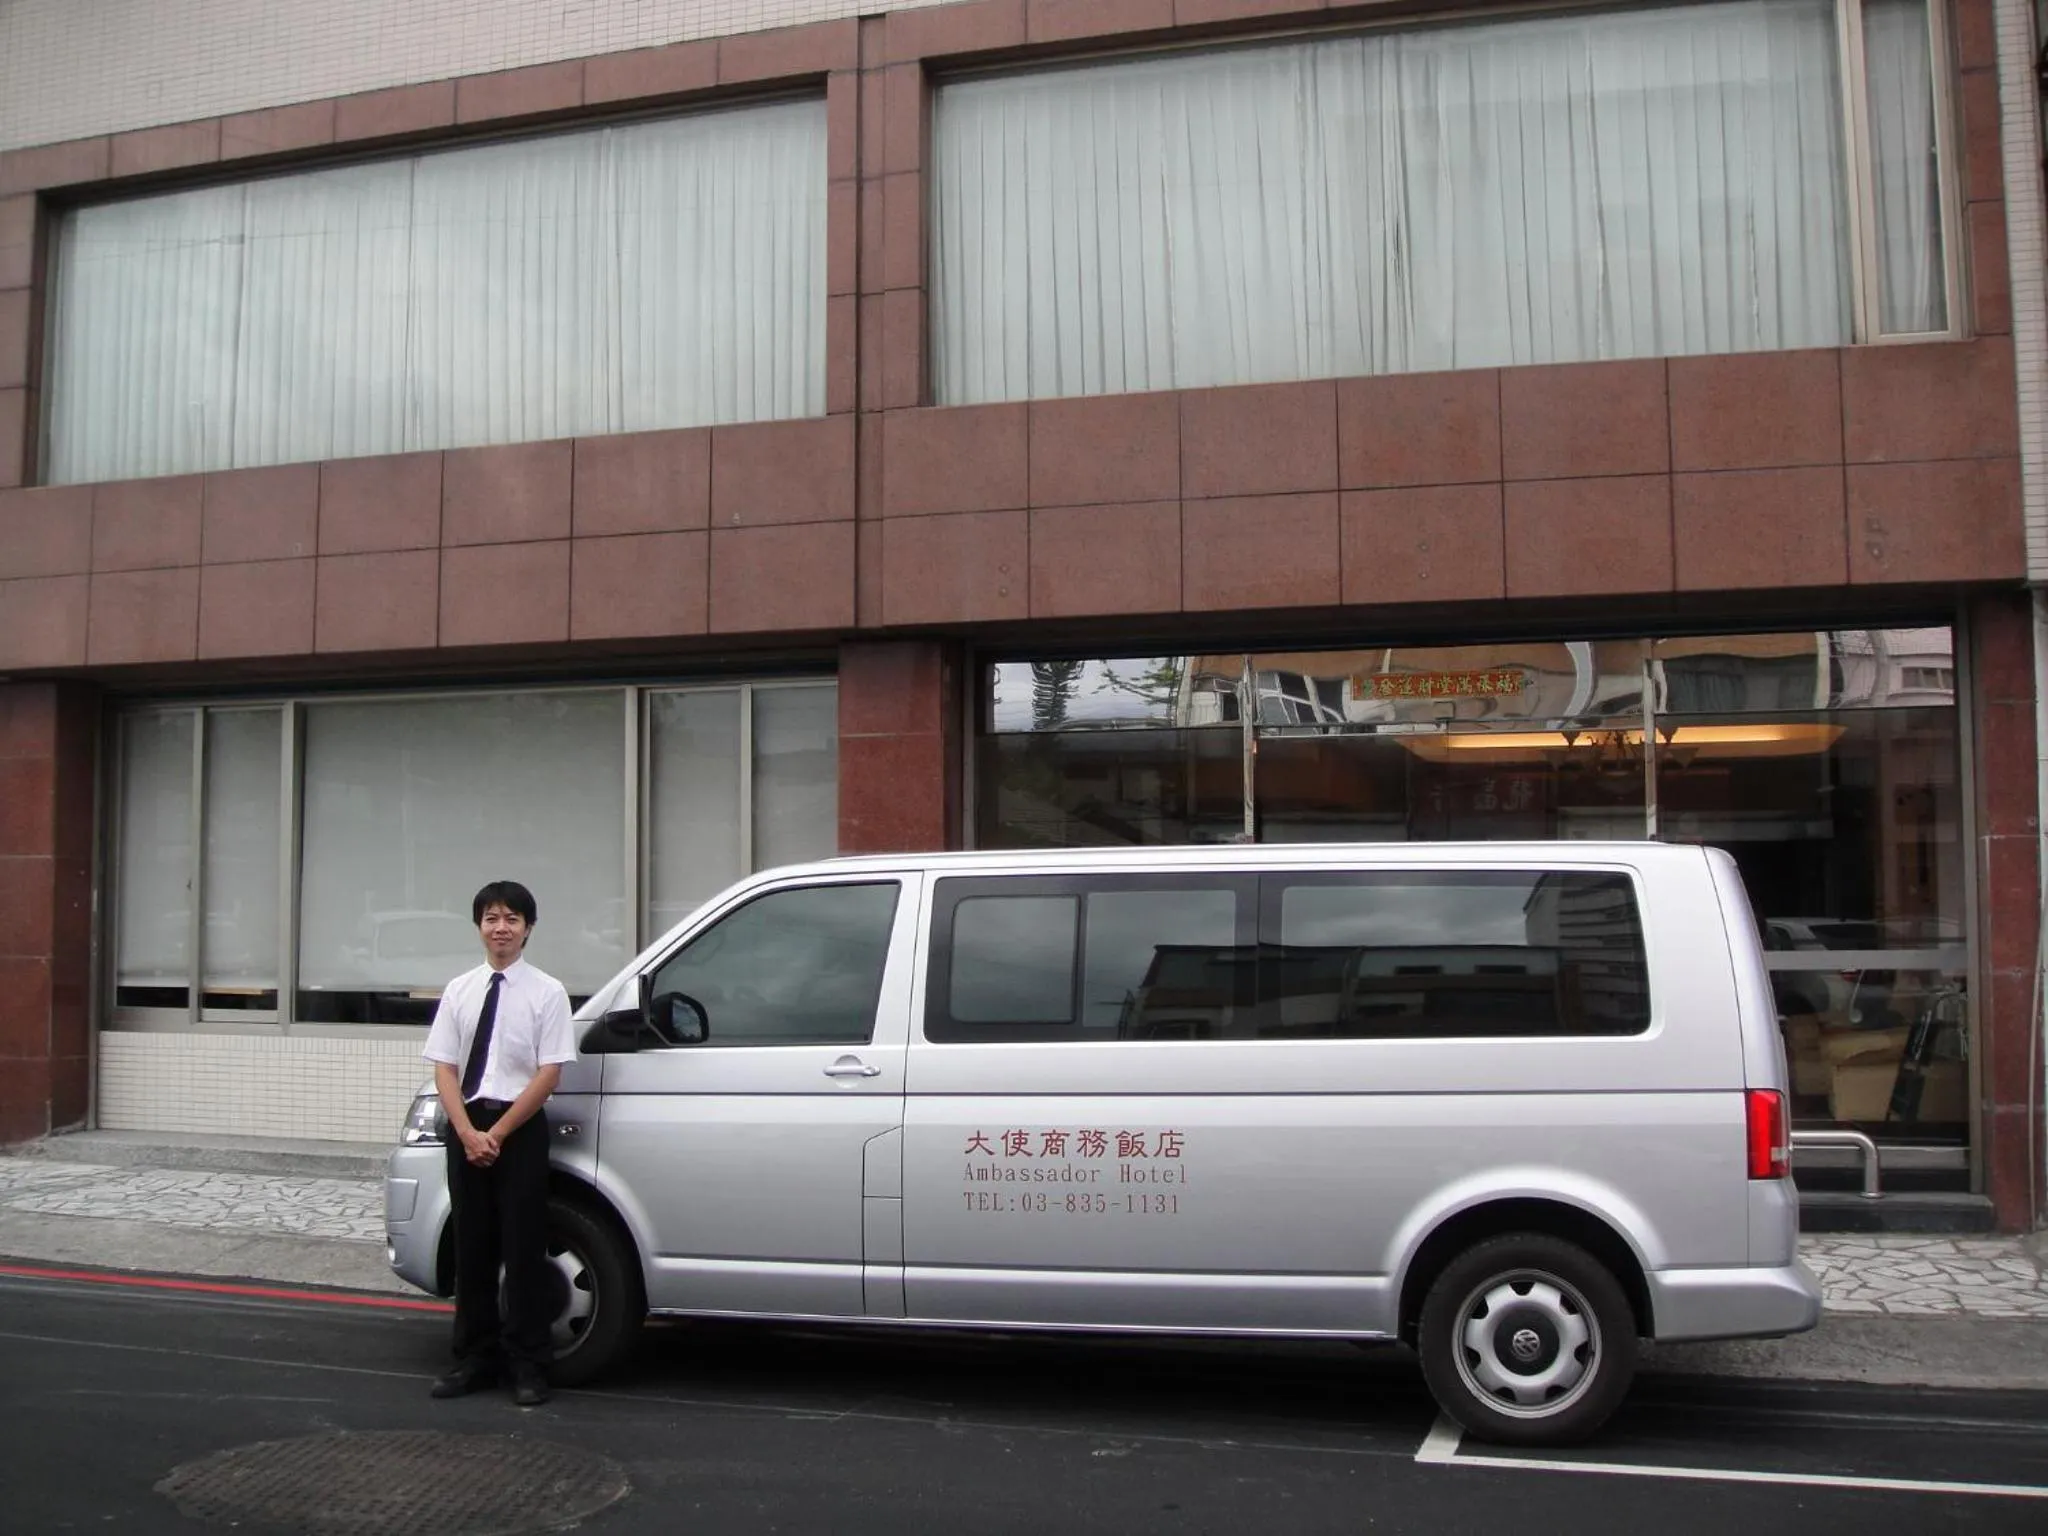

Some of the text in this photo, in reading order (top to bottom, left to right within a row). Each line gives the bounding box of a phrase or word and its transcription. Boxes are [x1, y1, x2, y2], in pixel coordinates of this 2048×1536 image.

[963, 1128, 1185, 1159] 大使商務飯店
[963, 1162, 1186, 1184] Ambassador Hotel
[963, 1191, 1179, 1214] TEL:03-835-1131
